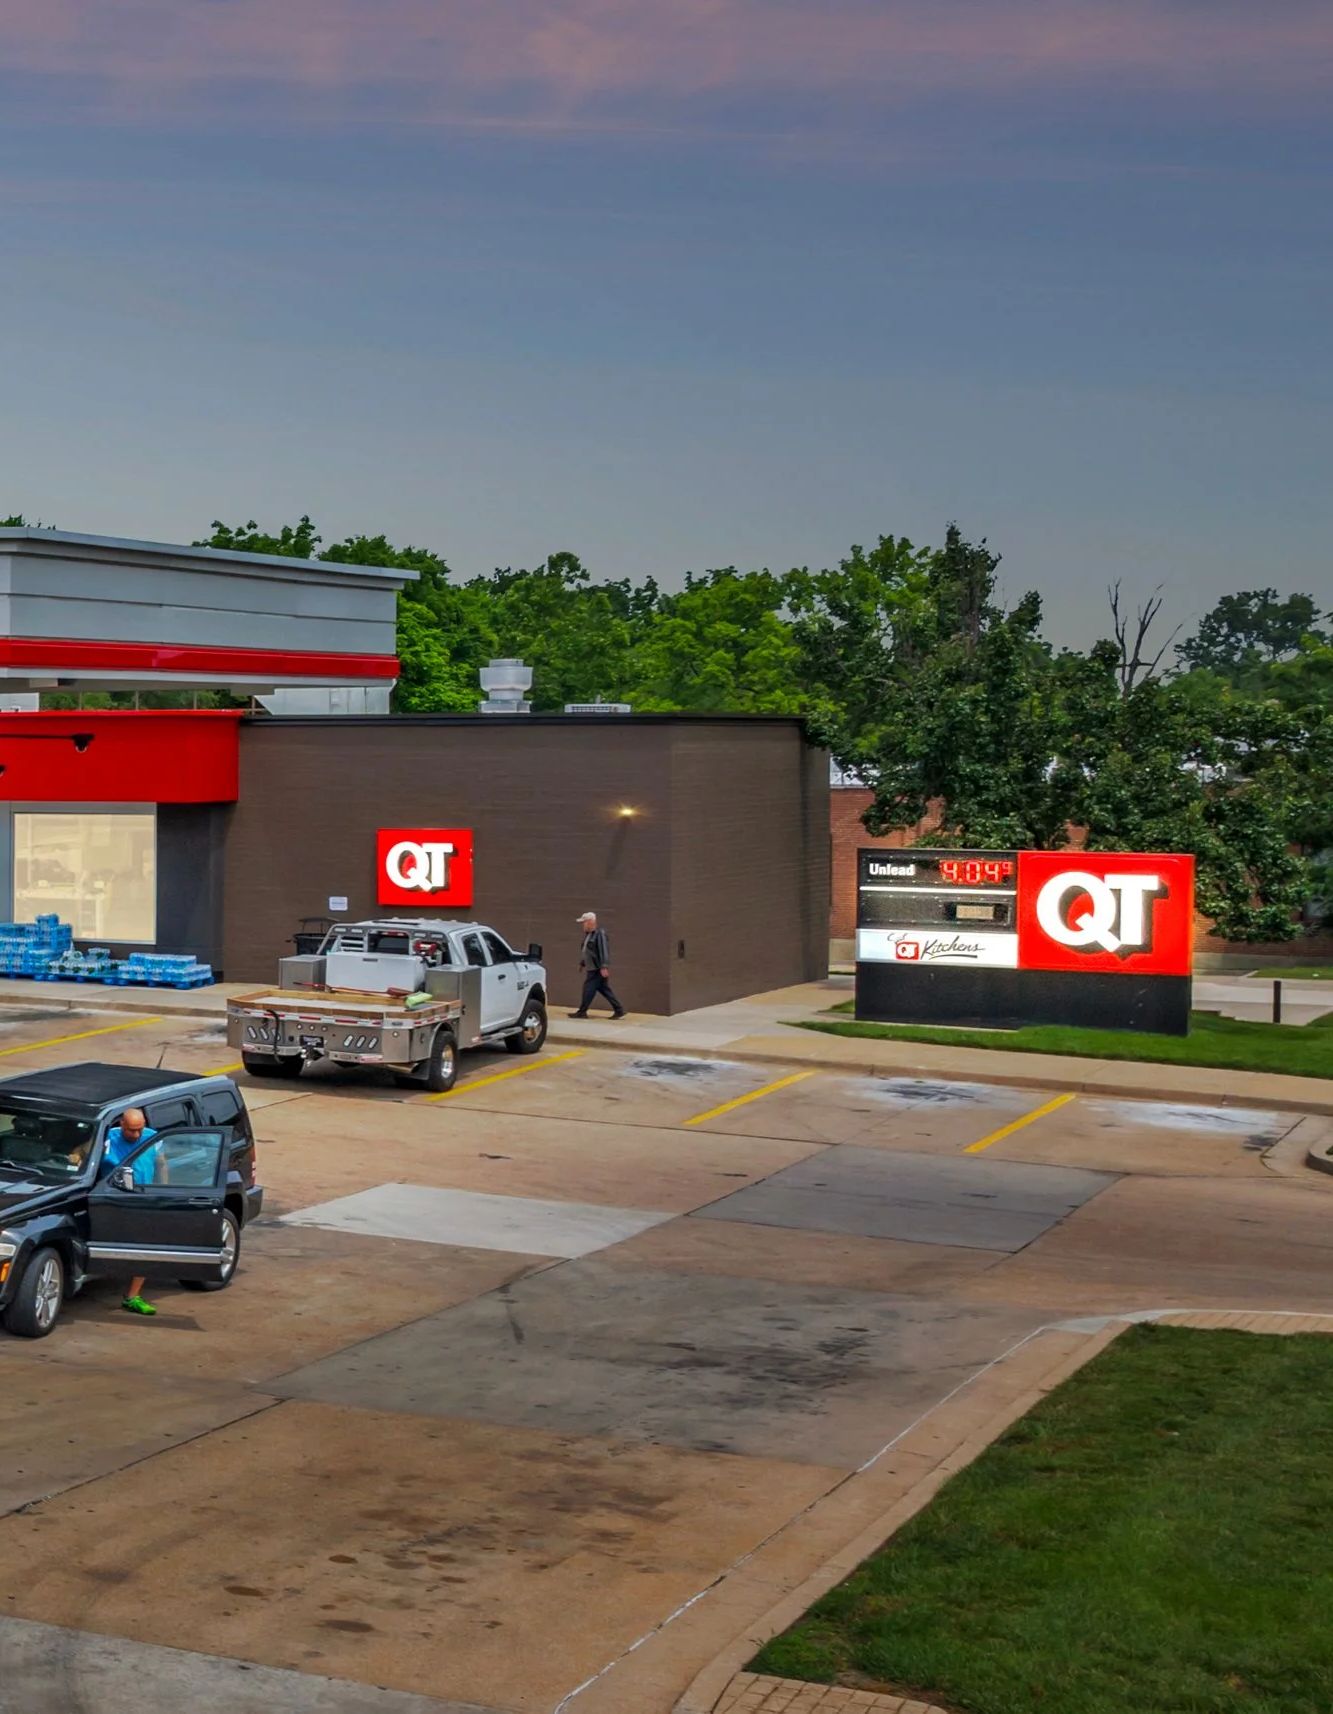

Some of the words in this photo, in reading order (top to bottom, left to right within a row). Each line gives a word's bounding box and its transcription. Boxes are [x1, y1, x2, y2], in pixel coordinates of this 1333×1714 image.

[385, 841, 453, 892] QT
[869, 862, 916, 876] Unlead
[1036, 871, 1159, 953] QT
[896, 943, 918, 958] QT
[920, 935, 985, 960] Kitchens
